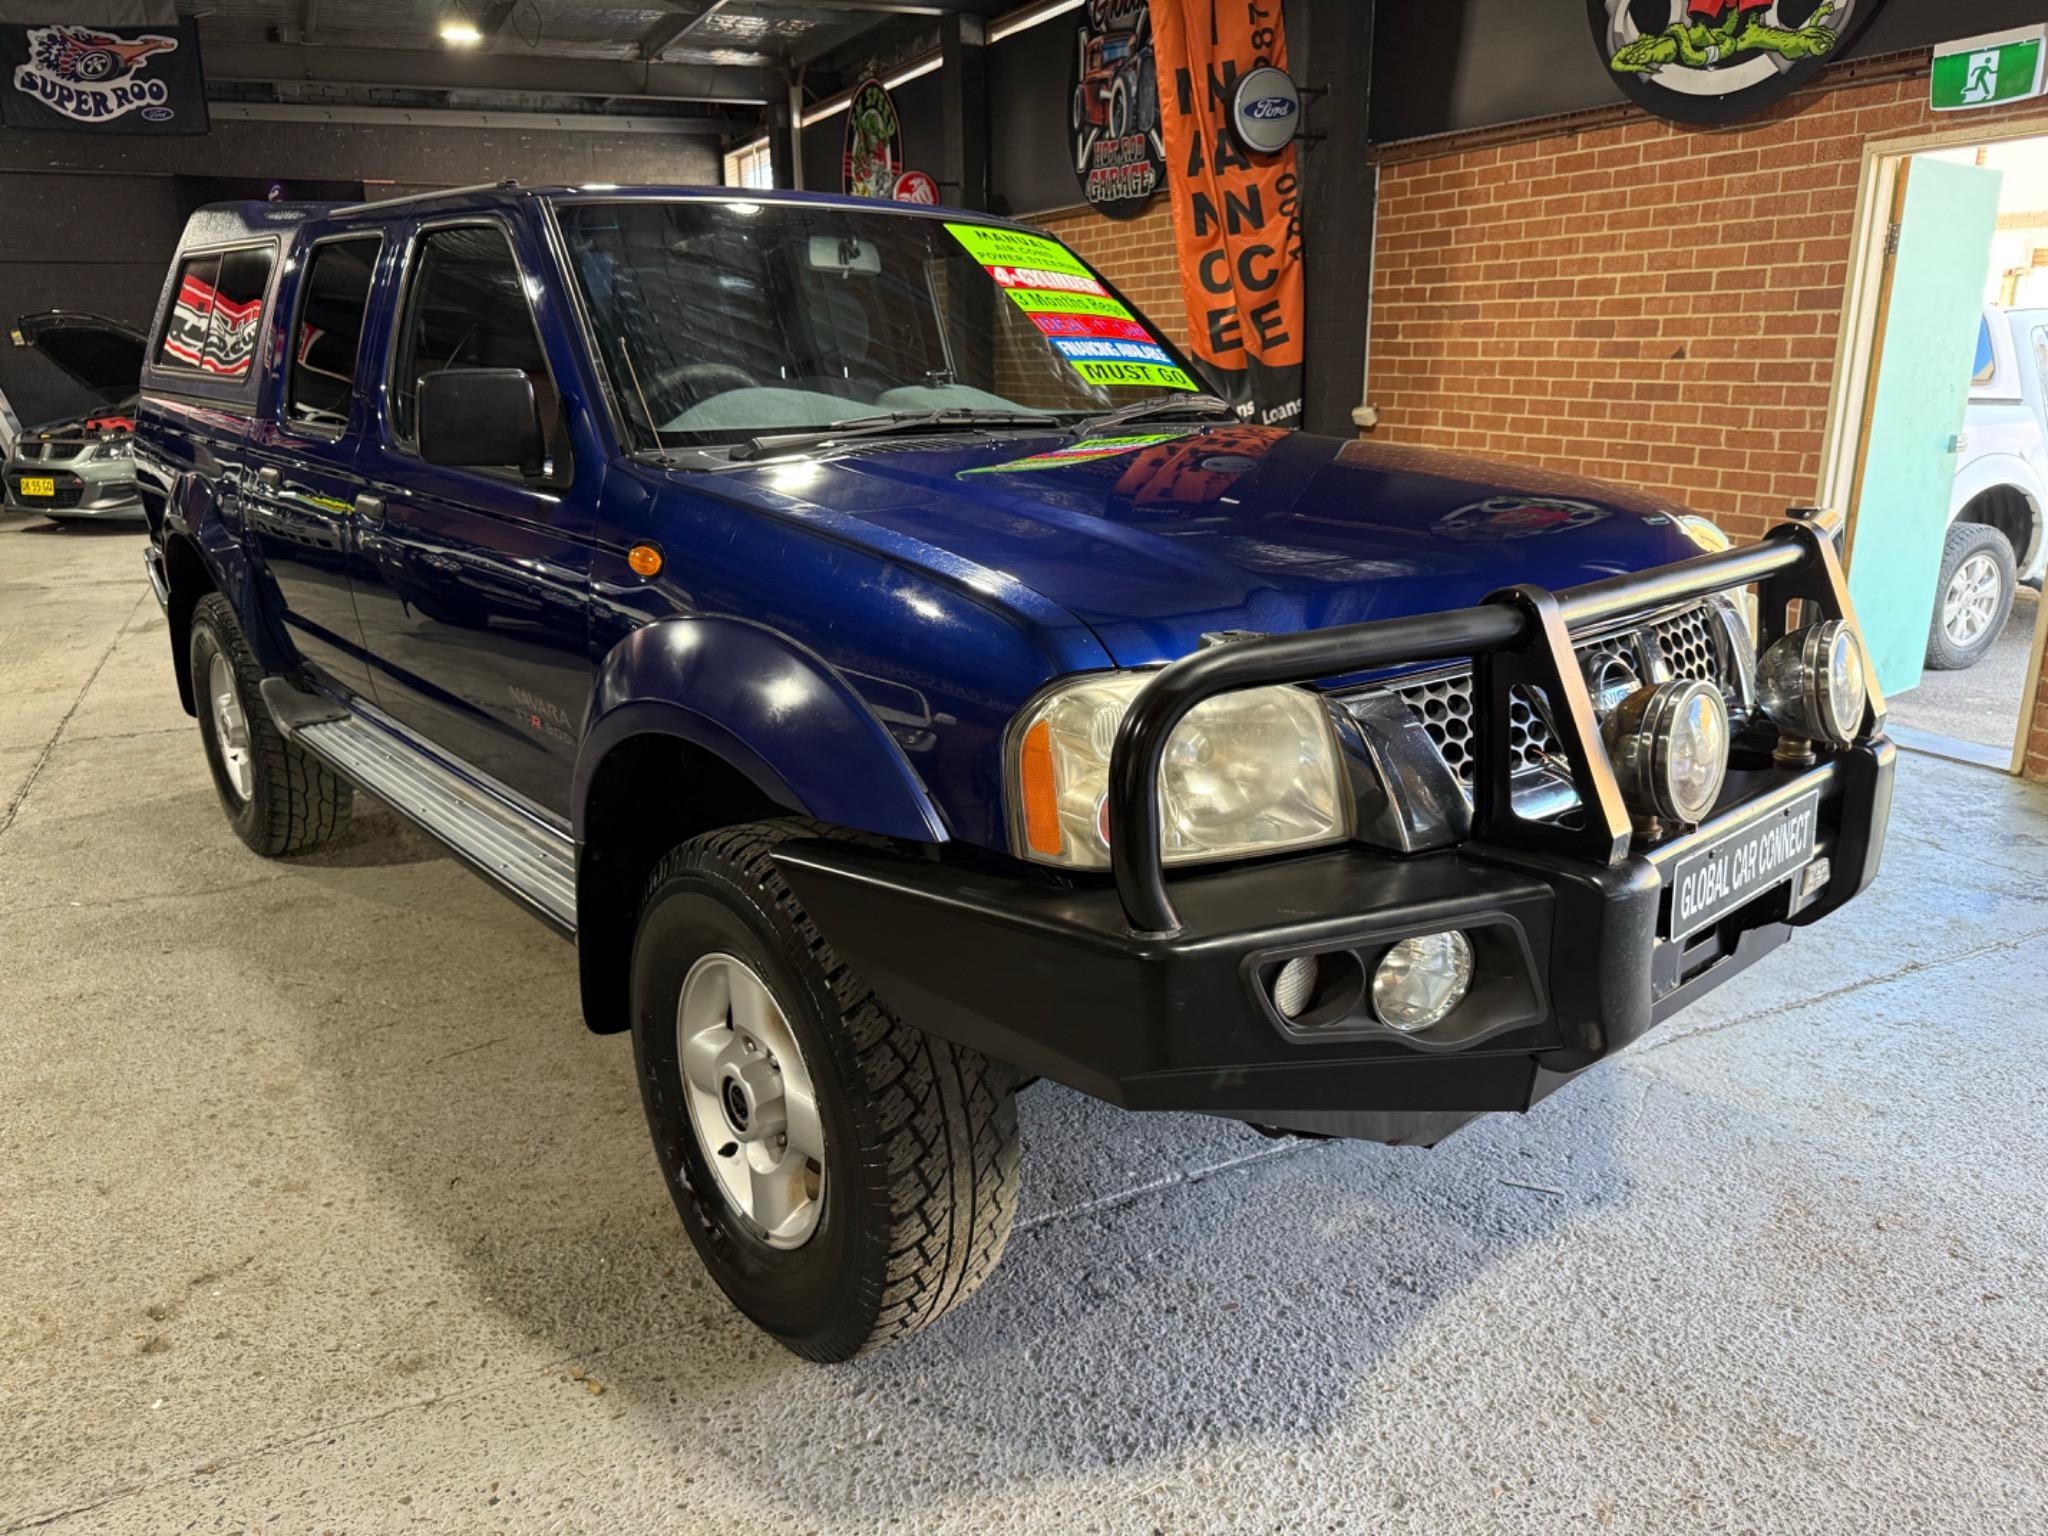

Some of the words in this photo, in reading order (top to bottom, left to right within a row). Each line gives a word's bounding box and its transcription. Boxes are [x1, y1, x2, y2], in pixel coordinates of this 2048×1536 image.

[20, 70, 114, 118] SUPER
[111, 81, 165, 109] ROO
[1253, 98, 1291, 120] Ford
[1093, 140, 1119, 168] HOT
[1120, 133, 1146, 162] ROD
[1089, 160, 1151, 203] GARAGE
[973, 230, 1051, 251] MANUAL
[976, 251, 1023, 263] POWER
[1013, 292, 1026, 307] 3
[1028, 292, 1086, 310] Months
[1035, 314, 1090, 334] IDEAL
[1083, 363, 1153, 381] MUST
[1158, 368, 1187, 385] GO
[508, 684, 572, 729] NAVARA
[1681, 857, 1730, 917] GLOBAL
[1732, 840, 1758, 888] CAR
[1758, 811, 1811, 874] CONNECT
